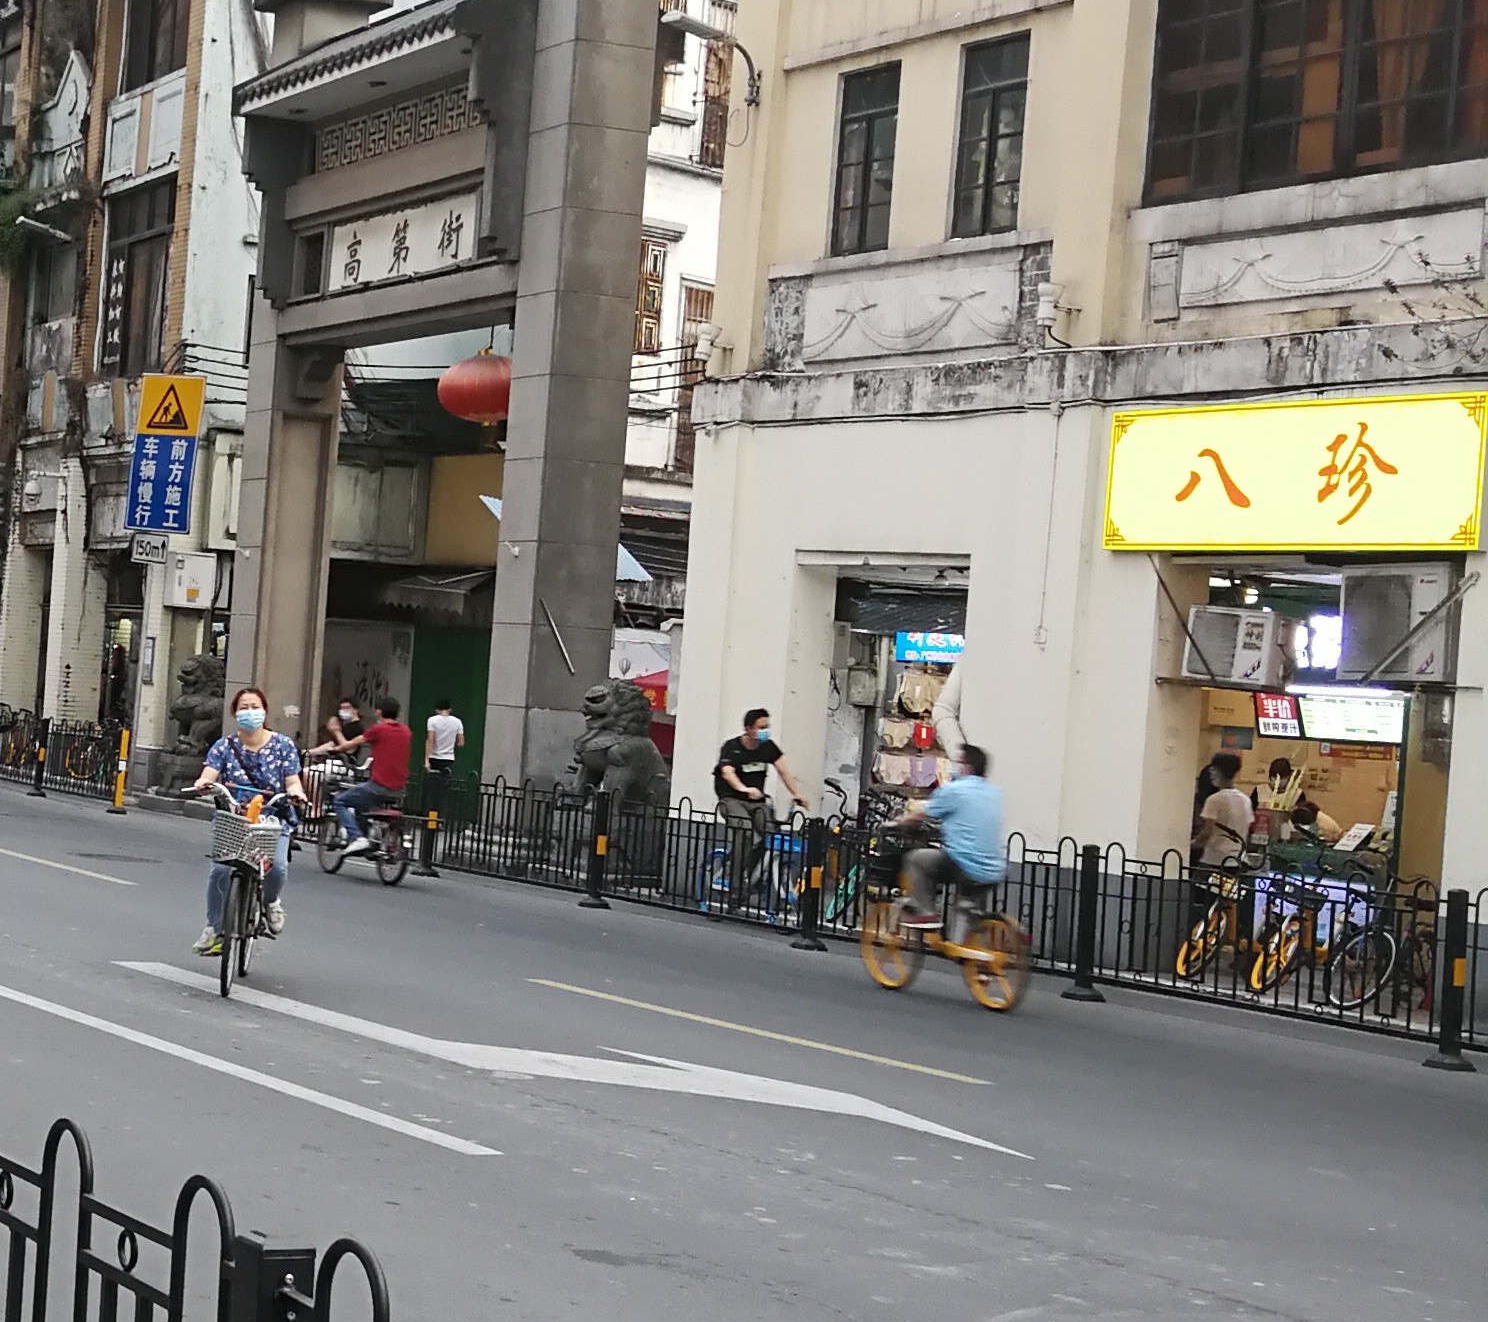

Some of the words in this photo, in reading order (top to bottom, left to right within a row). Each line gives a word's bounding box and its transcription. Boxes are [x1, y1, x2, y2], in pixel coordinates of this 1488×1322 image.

[344, 210, 463, 283] 高第街
[135, 436, 160, 527] 车辆慢行
[163, 438, 188, 528] 前方施工
[1175, 421, 1399, 525] 八珍
[135, 539, 160, 558] 150m
[1263, 698, 1292, 719] 半价
